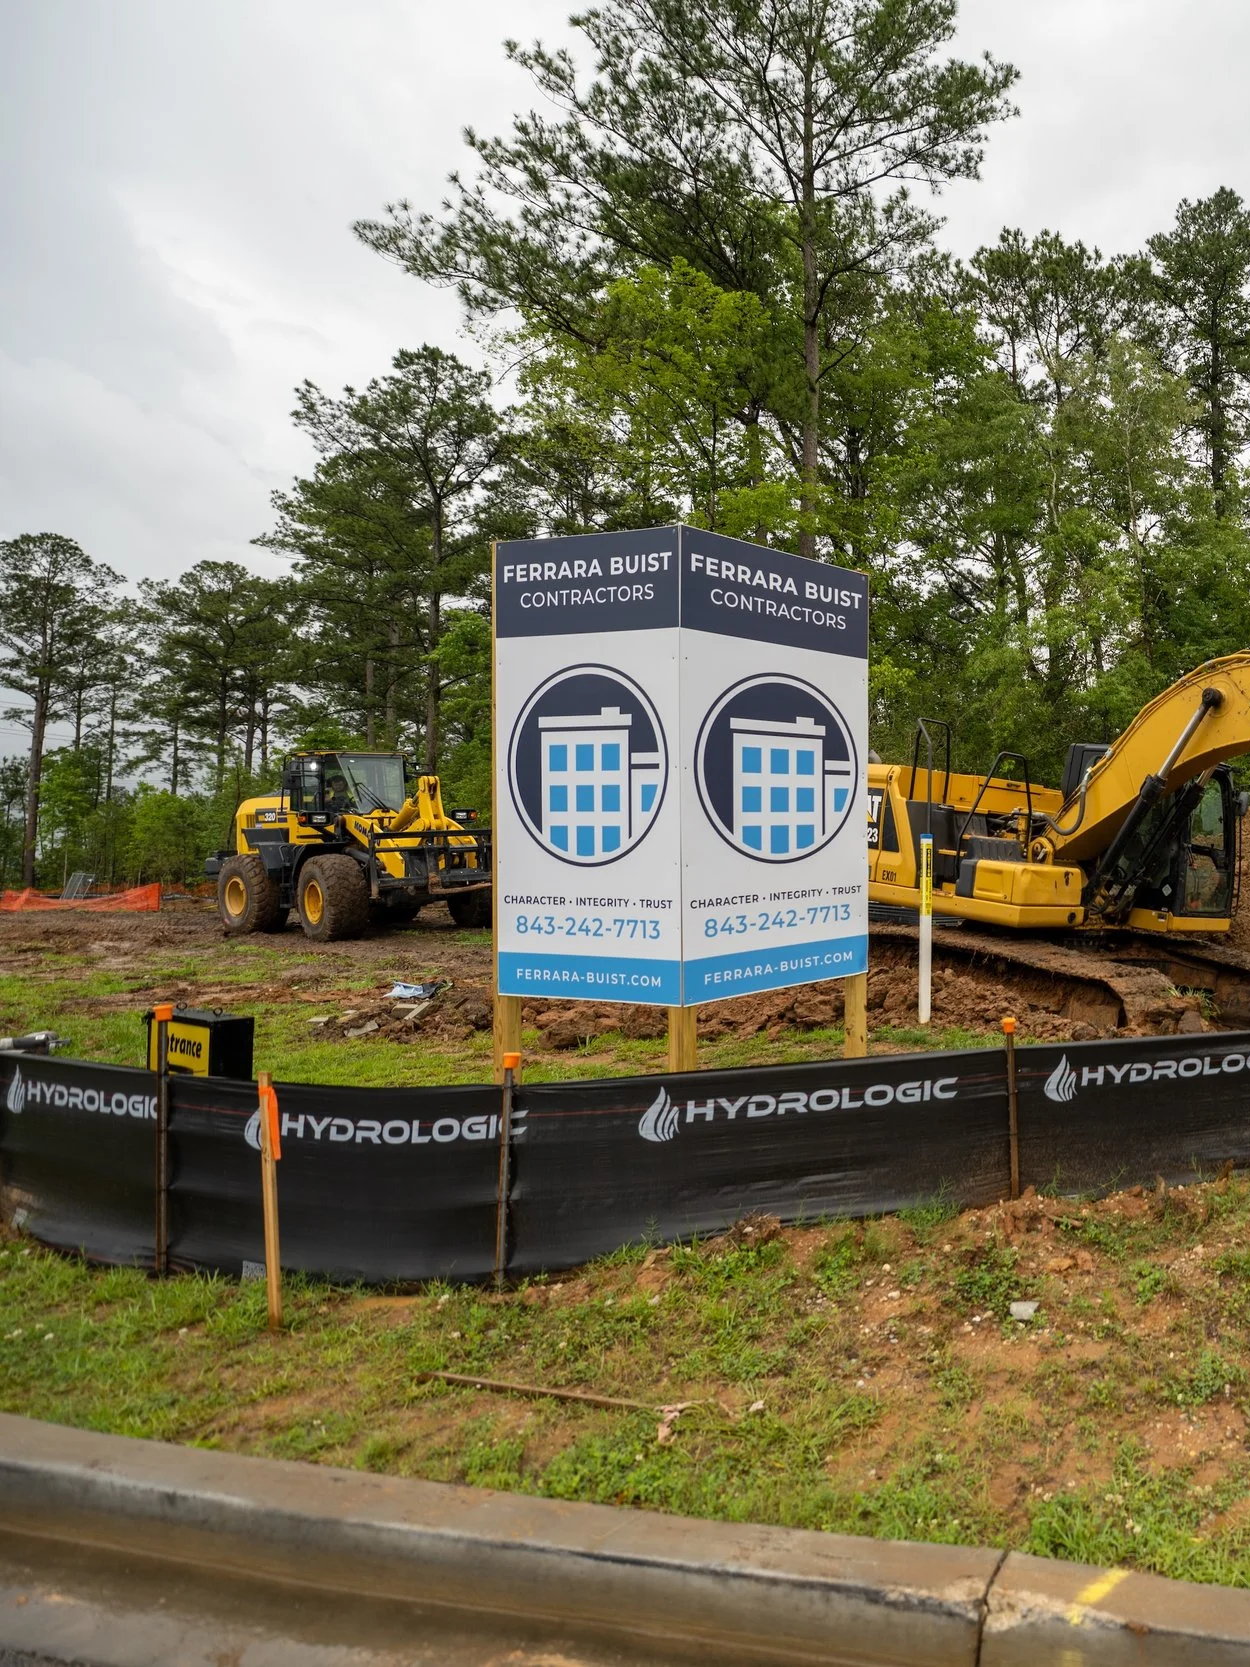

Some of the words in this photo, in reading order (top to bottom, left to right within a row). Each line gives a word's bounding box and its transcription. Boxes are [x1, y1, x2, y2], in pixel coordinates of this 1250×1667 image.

[504, 558, 602, 583] FERRARA
[609, 551, 672, 576] BUIST
[690, 553, 798, 596] FERRARA
[805, 580, 863, 609] BUIST
[520, 584, 654, 609] CONTRACTORS
[710, 589, 846, 630] CONTRACTORS
[882, 869, 897, 882] EX01
[504, 895, 566, 907] CHARACTER
[575, 897, 630, 908] INTEGRITY
[639, 899, 673, 910] TRUST
[690, 894, 759, 910] CHARACTER
[769, 888, 823, 902] INTEGRITY
[832, 885, 862, 896] TRUST
[516, 915, 661, 940] 843-242-7713
[704, 903, 851, 939] 843-242-7713
[516, 968, 662, 988] FERRARA-BUIST.COM
[704, 950, 854, 986] FERRARA-BUIST.COM
[167, 1033, 203, 1059] trance
[685, 1077, 958, 1125] HYDROLOGIC
[281, 1109, 529, 1144] HYDROLOGIC
